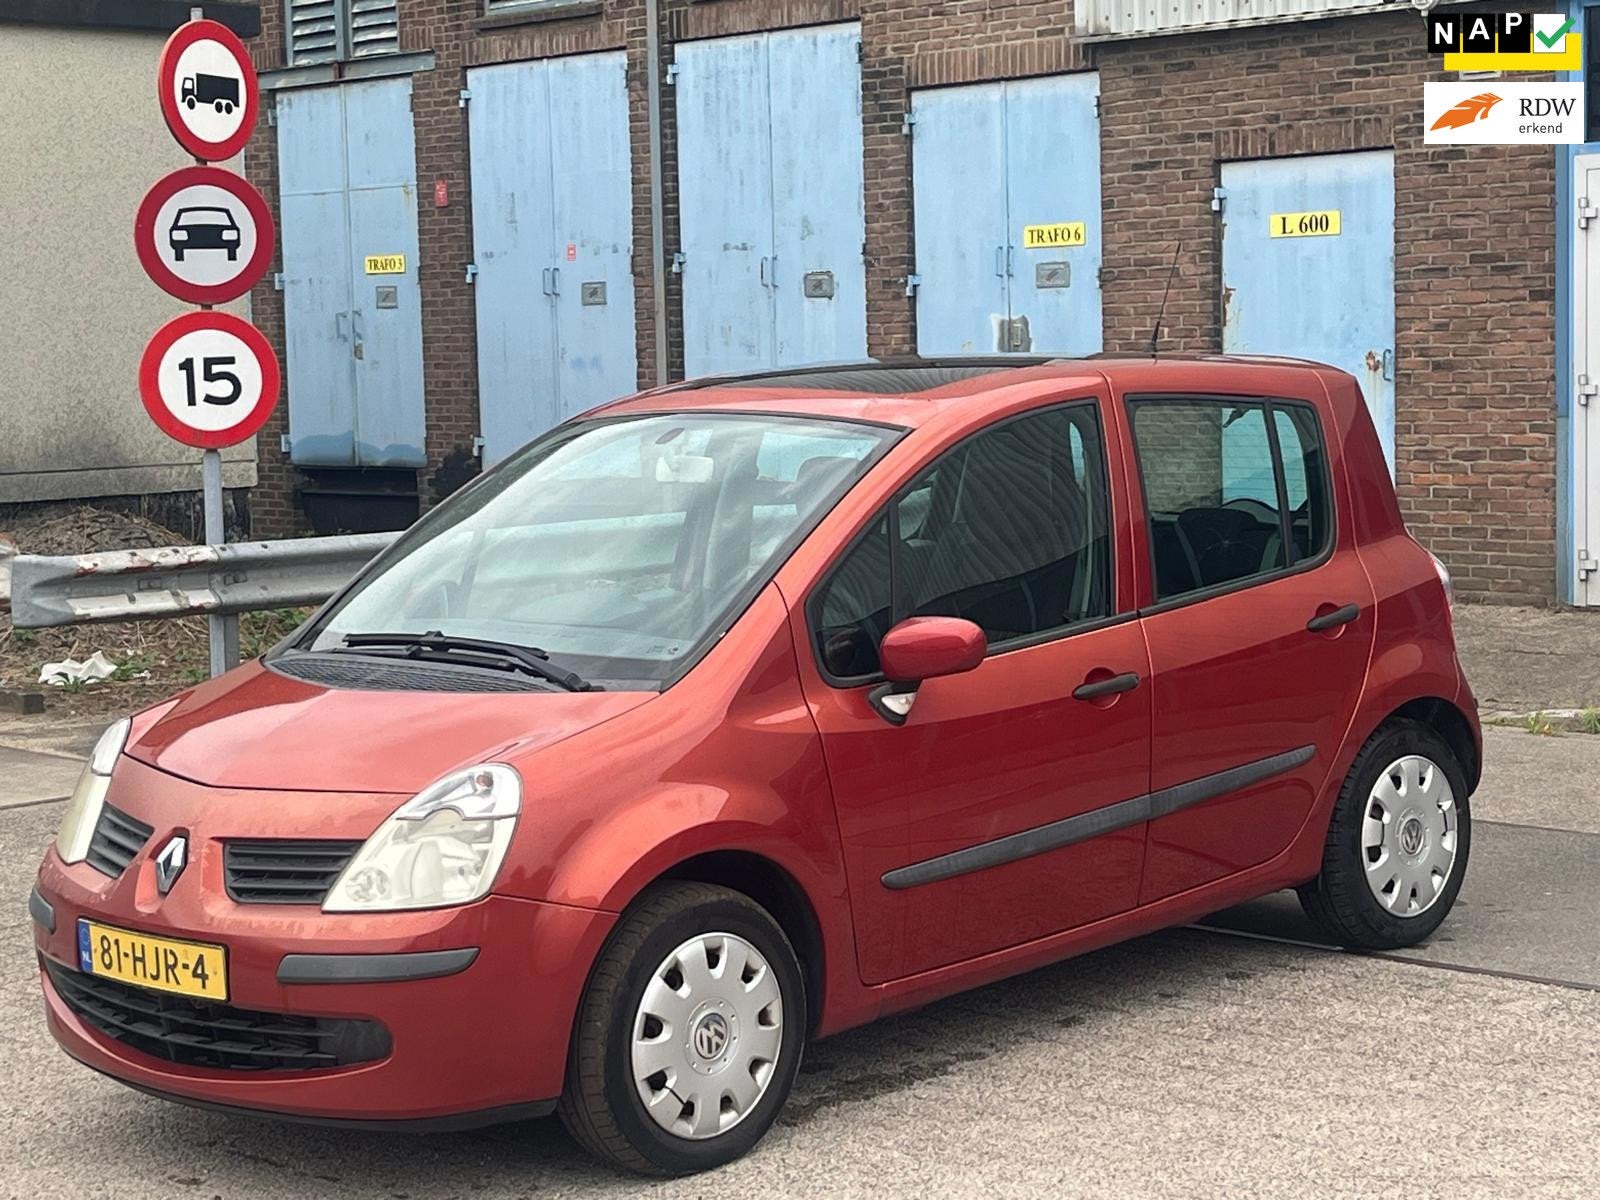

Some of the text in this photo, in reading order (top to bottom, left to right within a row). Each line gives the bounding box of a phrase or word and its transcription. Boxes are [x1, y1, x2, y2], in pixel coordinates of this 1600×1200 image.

[1028, 226, 1081, 244] TRAFO 6
[1281, 213, 1329, 235] L 600
[367, 258, 396, 271] TRAFO
[178, 355, 242, 407] 15
[100, 934, 209, 990] 81-HJR-4
